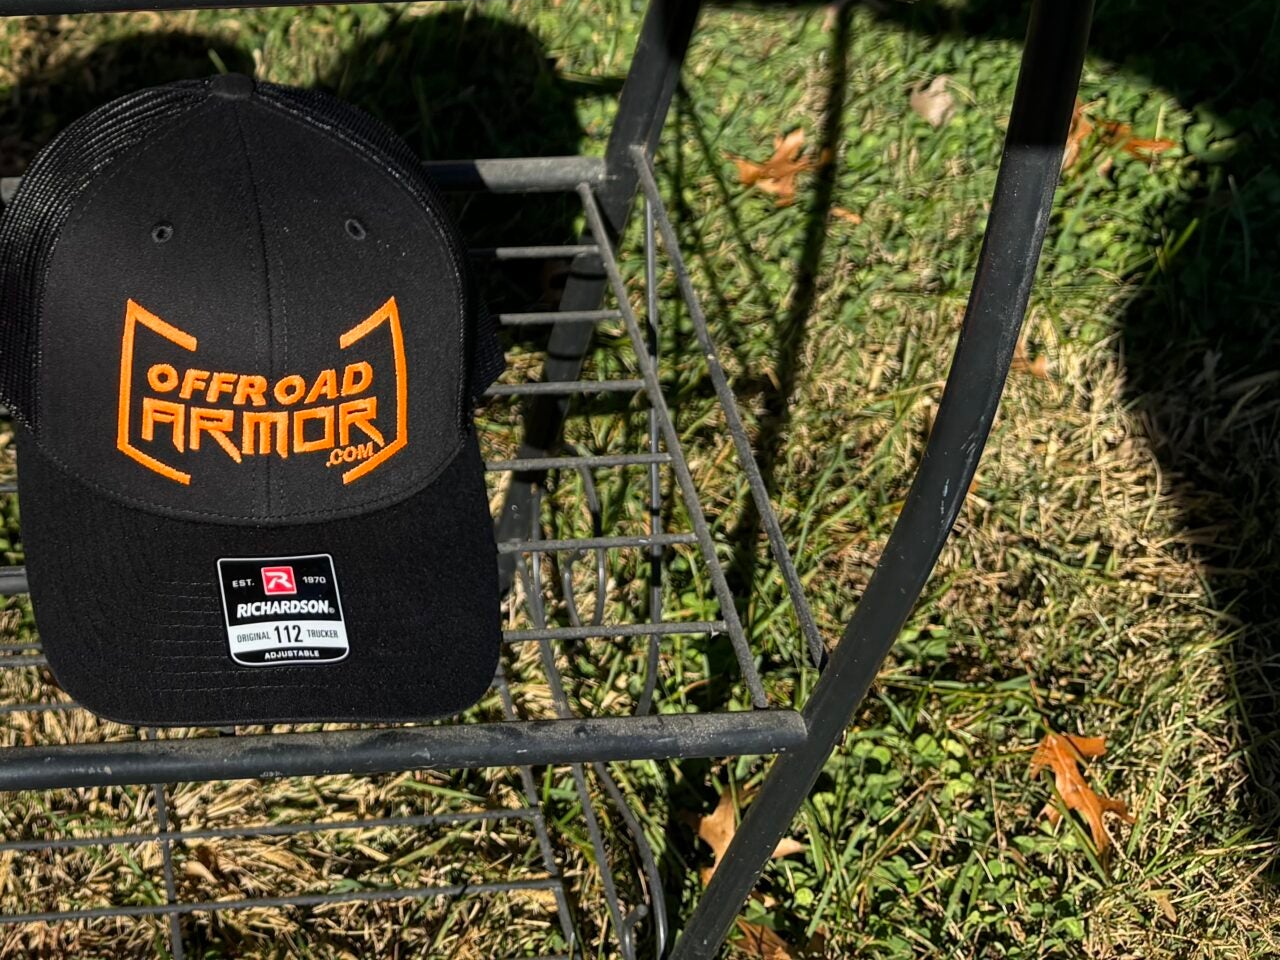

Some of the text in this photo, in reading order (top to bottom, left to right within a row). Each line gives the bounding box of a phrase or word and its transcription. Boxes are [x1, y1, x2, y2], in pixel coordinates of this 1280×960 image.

[147, 361, 373, 406] OFFROAD
[142, 396, 385, 464] ARMOR
[237, 625, 338, 643] ORIGINAL 112 TRUCKER
[265, 650, 319, 659] ADJUSTABLE
